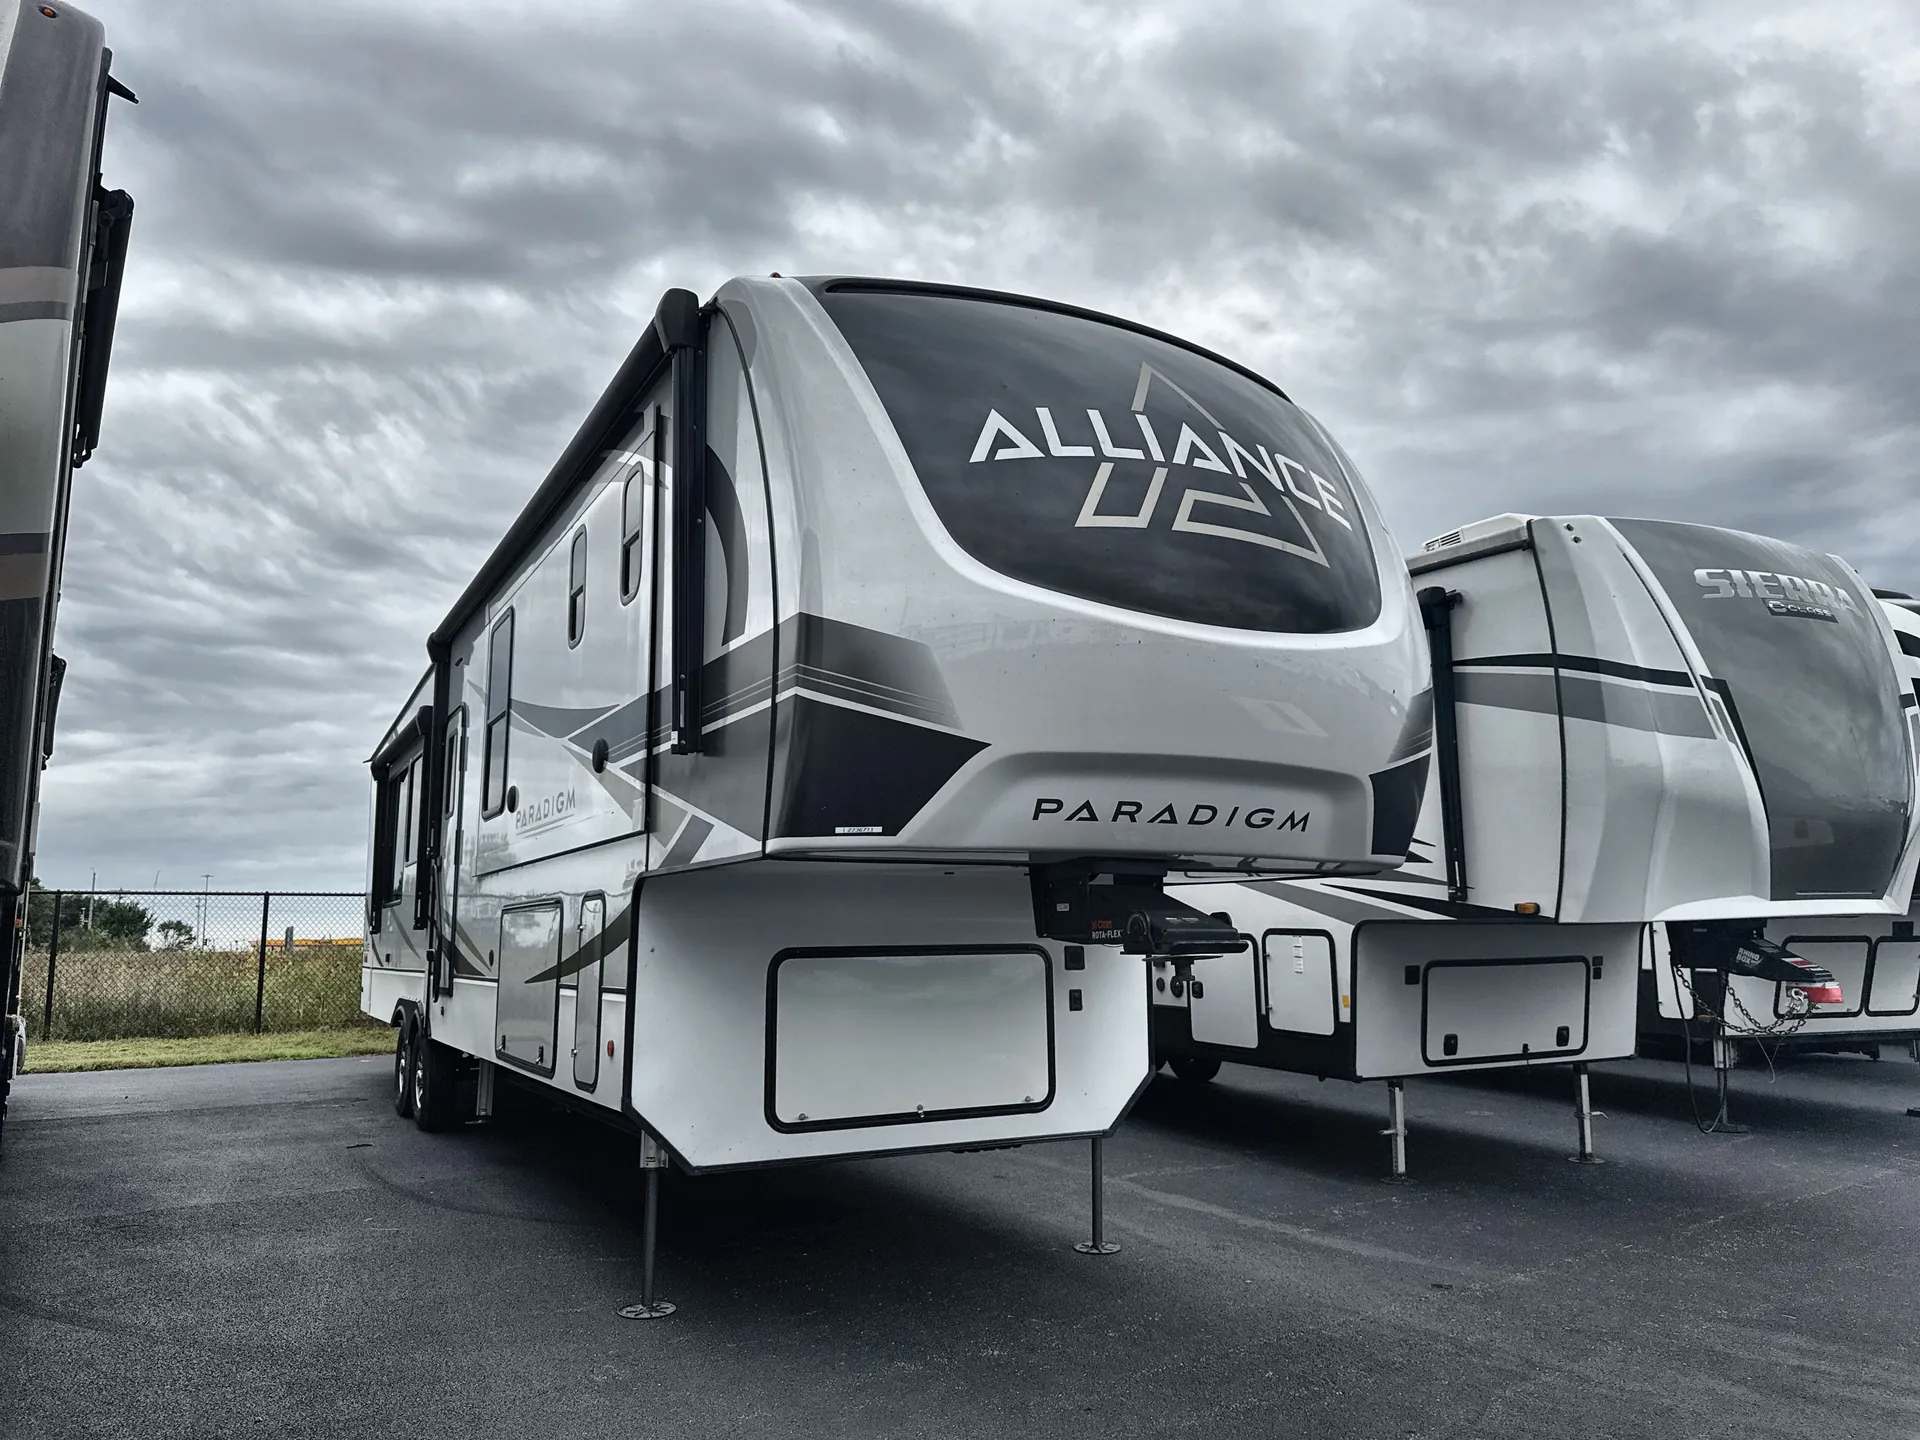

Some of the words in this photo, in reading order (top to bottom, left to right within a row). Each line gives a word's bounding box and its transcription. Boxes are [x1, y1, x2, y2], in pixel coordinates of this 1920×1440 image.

[969, 406, 1352, 532] ALLIANCE
[1694, 568, 1865, 619] SIERRA
[515, 786, 576, 830] PARADIGM
[1032, 798, 1311, 833] PARADIGM
[1736, 953, 1750, 965] BOX
[1738, 947, 1760, 961] RHINO
